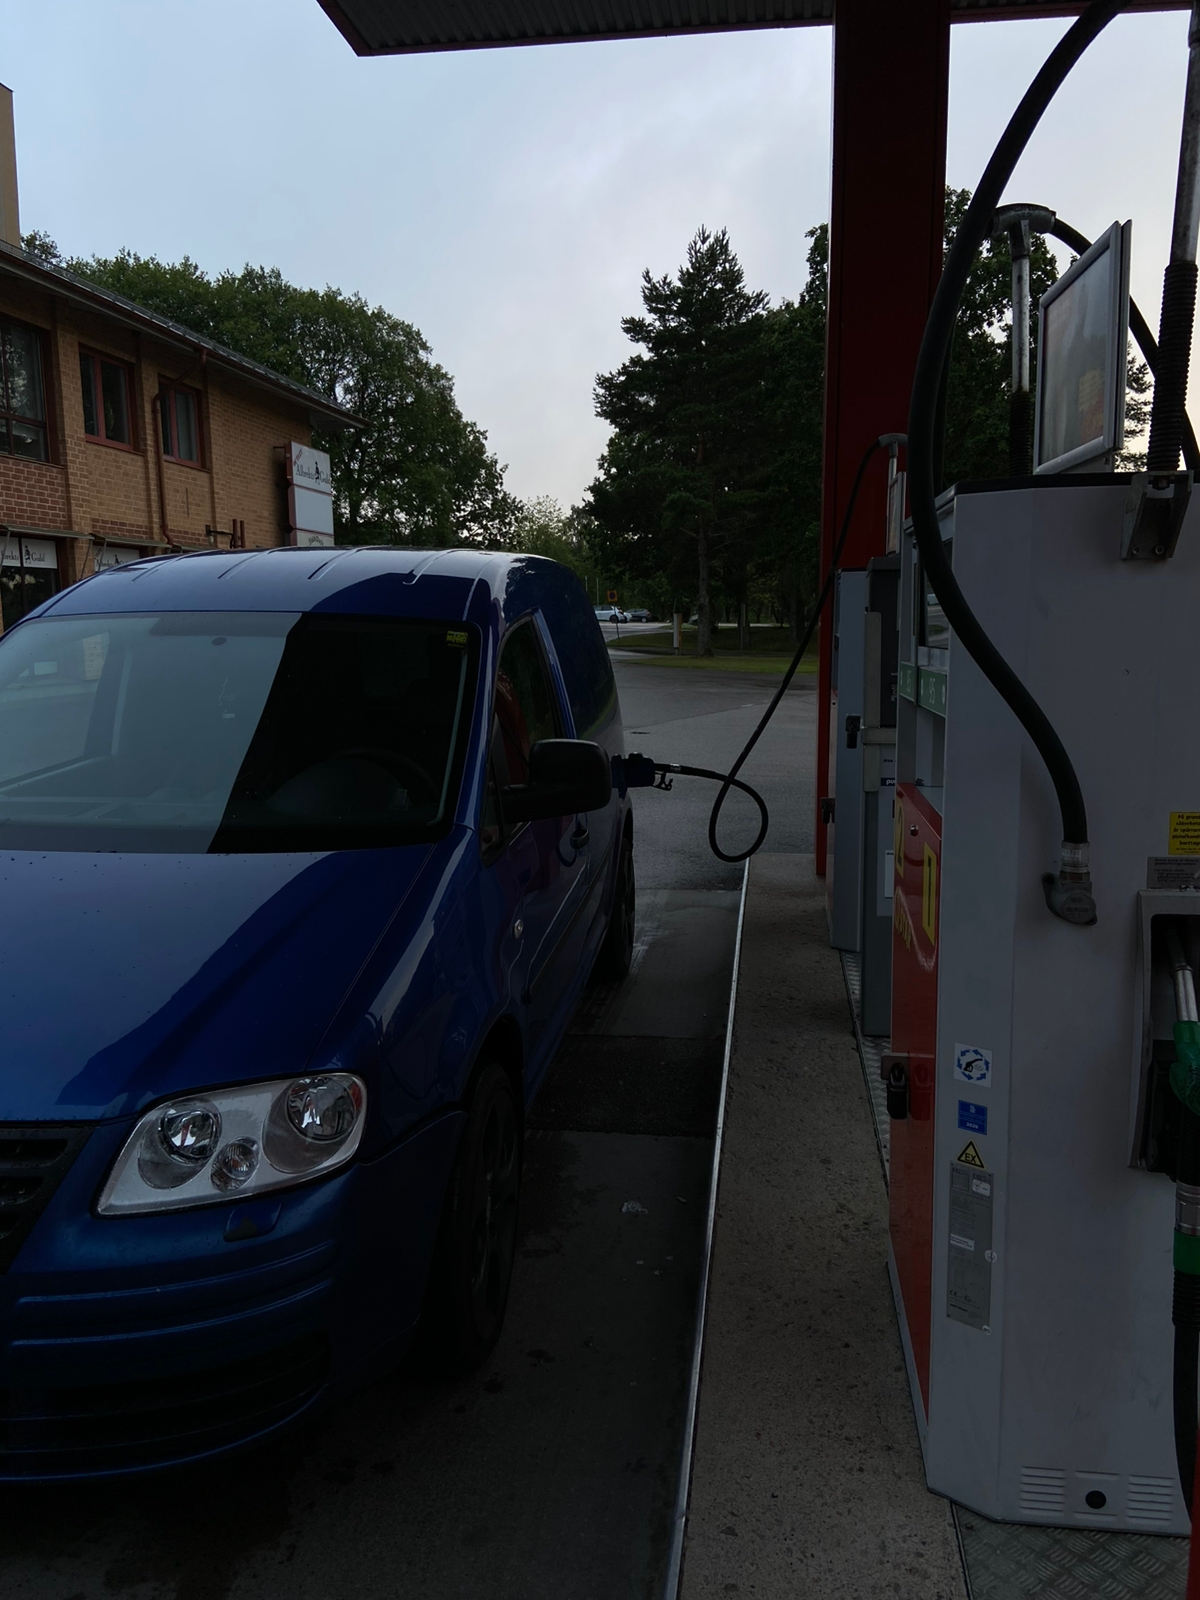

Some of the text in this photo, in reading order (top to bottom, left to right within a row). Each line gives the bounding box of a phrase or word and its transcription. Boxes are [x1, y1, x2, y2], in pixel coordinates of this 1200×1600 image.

[31, 552, 45, 562] Guld
[929, 677, 936, 704] 95
[897, 806, 903, 867] 2
[964, 1153, 976, 1164] EX
